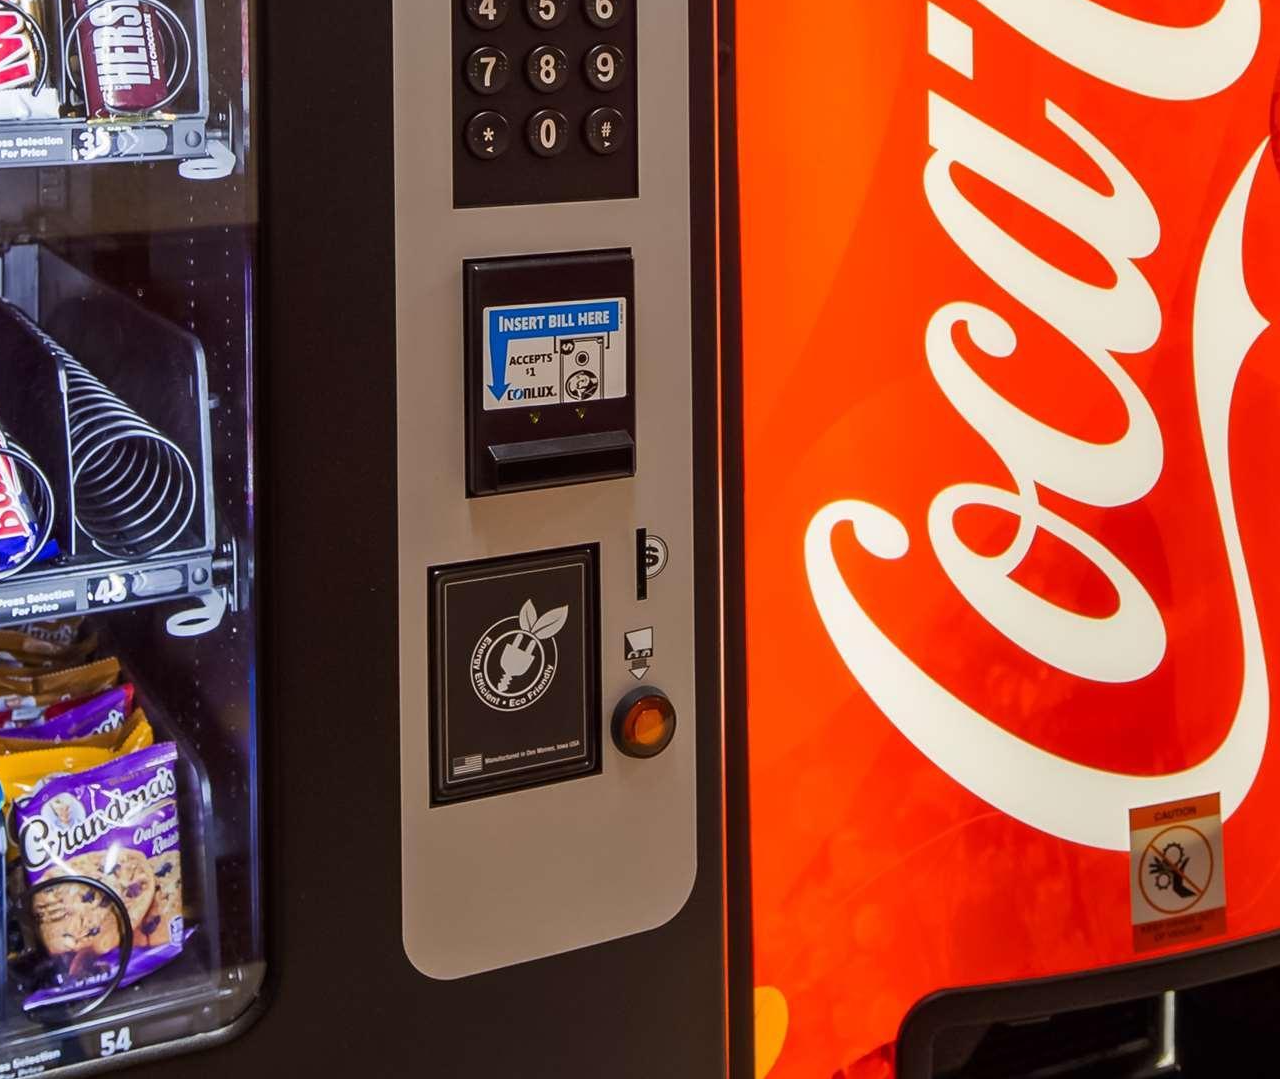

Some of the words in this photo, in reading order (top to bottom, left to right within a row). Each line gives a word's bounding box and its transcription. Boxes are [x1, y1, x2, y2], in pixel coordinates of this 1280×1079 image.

[479, 56, 497, 87] 7
[539, 54, 556, 85] 8
[595, 52, 615, 83] 9
[14, 136, 64, 148] Selection
[539, 118, 557, 149] 0
[0, 148, 19, 159] For
[21, 147, 48, 159] Price
[498, 314, 546, 333] INSERT
[548, 312, 576, 329] BILL
[578, 310, 610, 326] HERE
[509, 352, 553, 366] ACCEPTS
[525, 367, 536, 378] $1
[26, 587, 76, 605] Selection
[11, 605, 31, 618] For
[32, 600, 60, 614] Price
[473, 636, 492, 670] Energy
[474, 672, 500, 705] Efficient
[509, 698, 527, 708] Eco
[527, 664, 555, 700] Friendly
[21, 768, 177, 868] Grandma's
[1154, 806, 1196, 821] CAUTION
[133, 818, 178, 844] Oatme
[99, 1026, 133, 1057] 54
